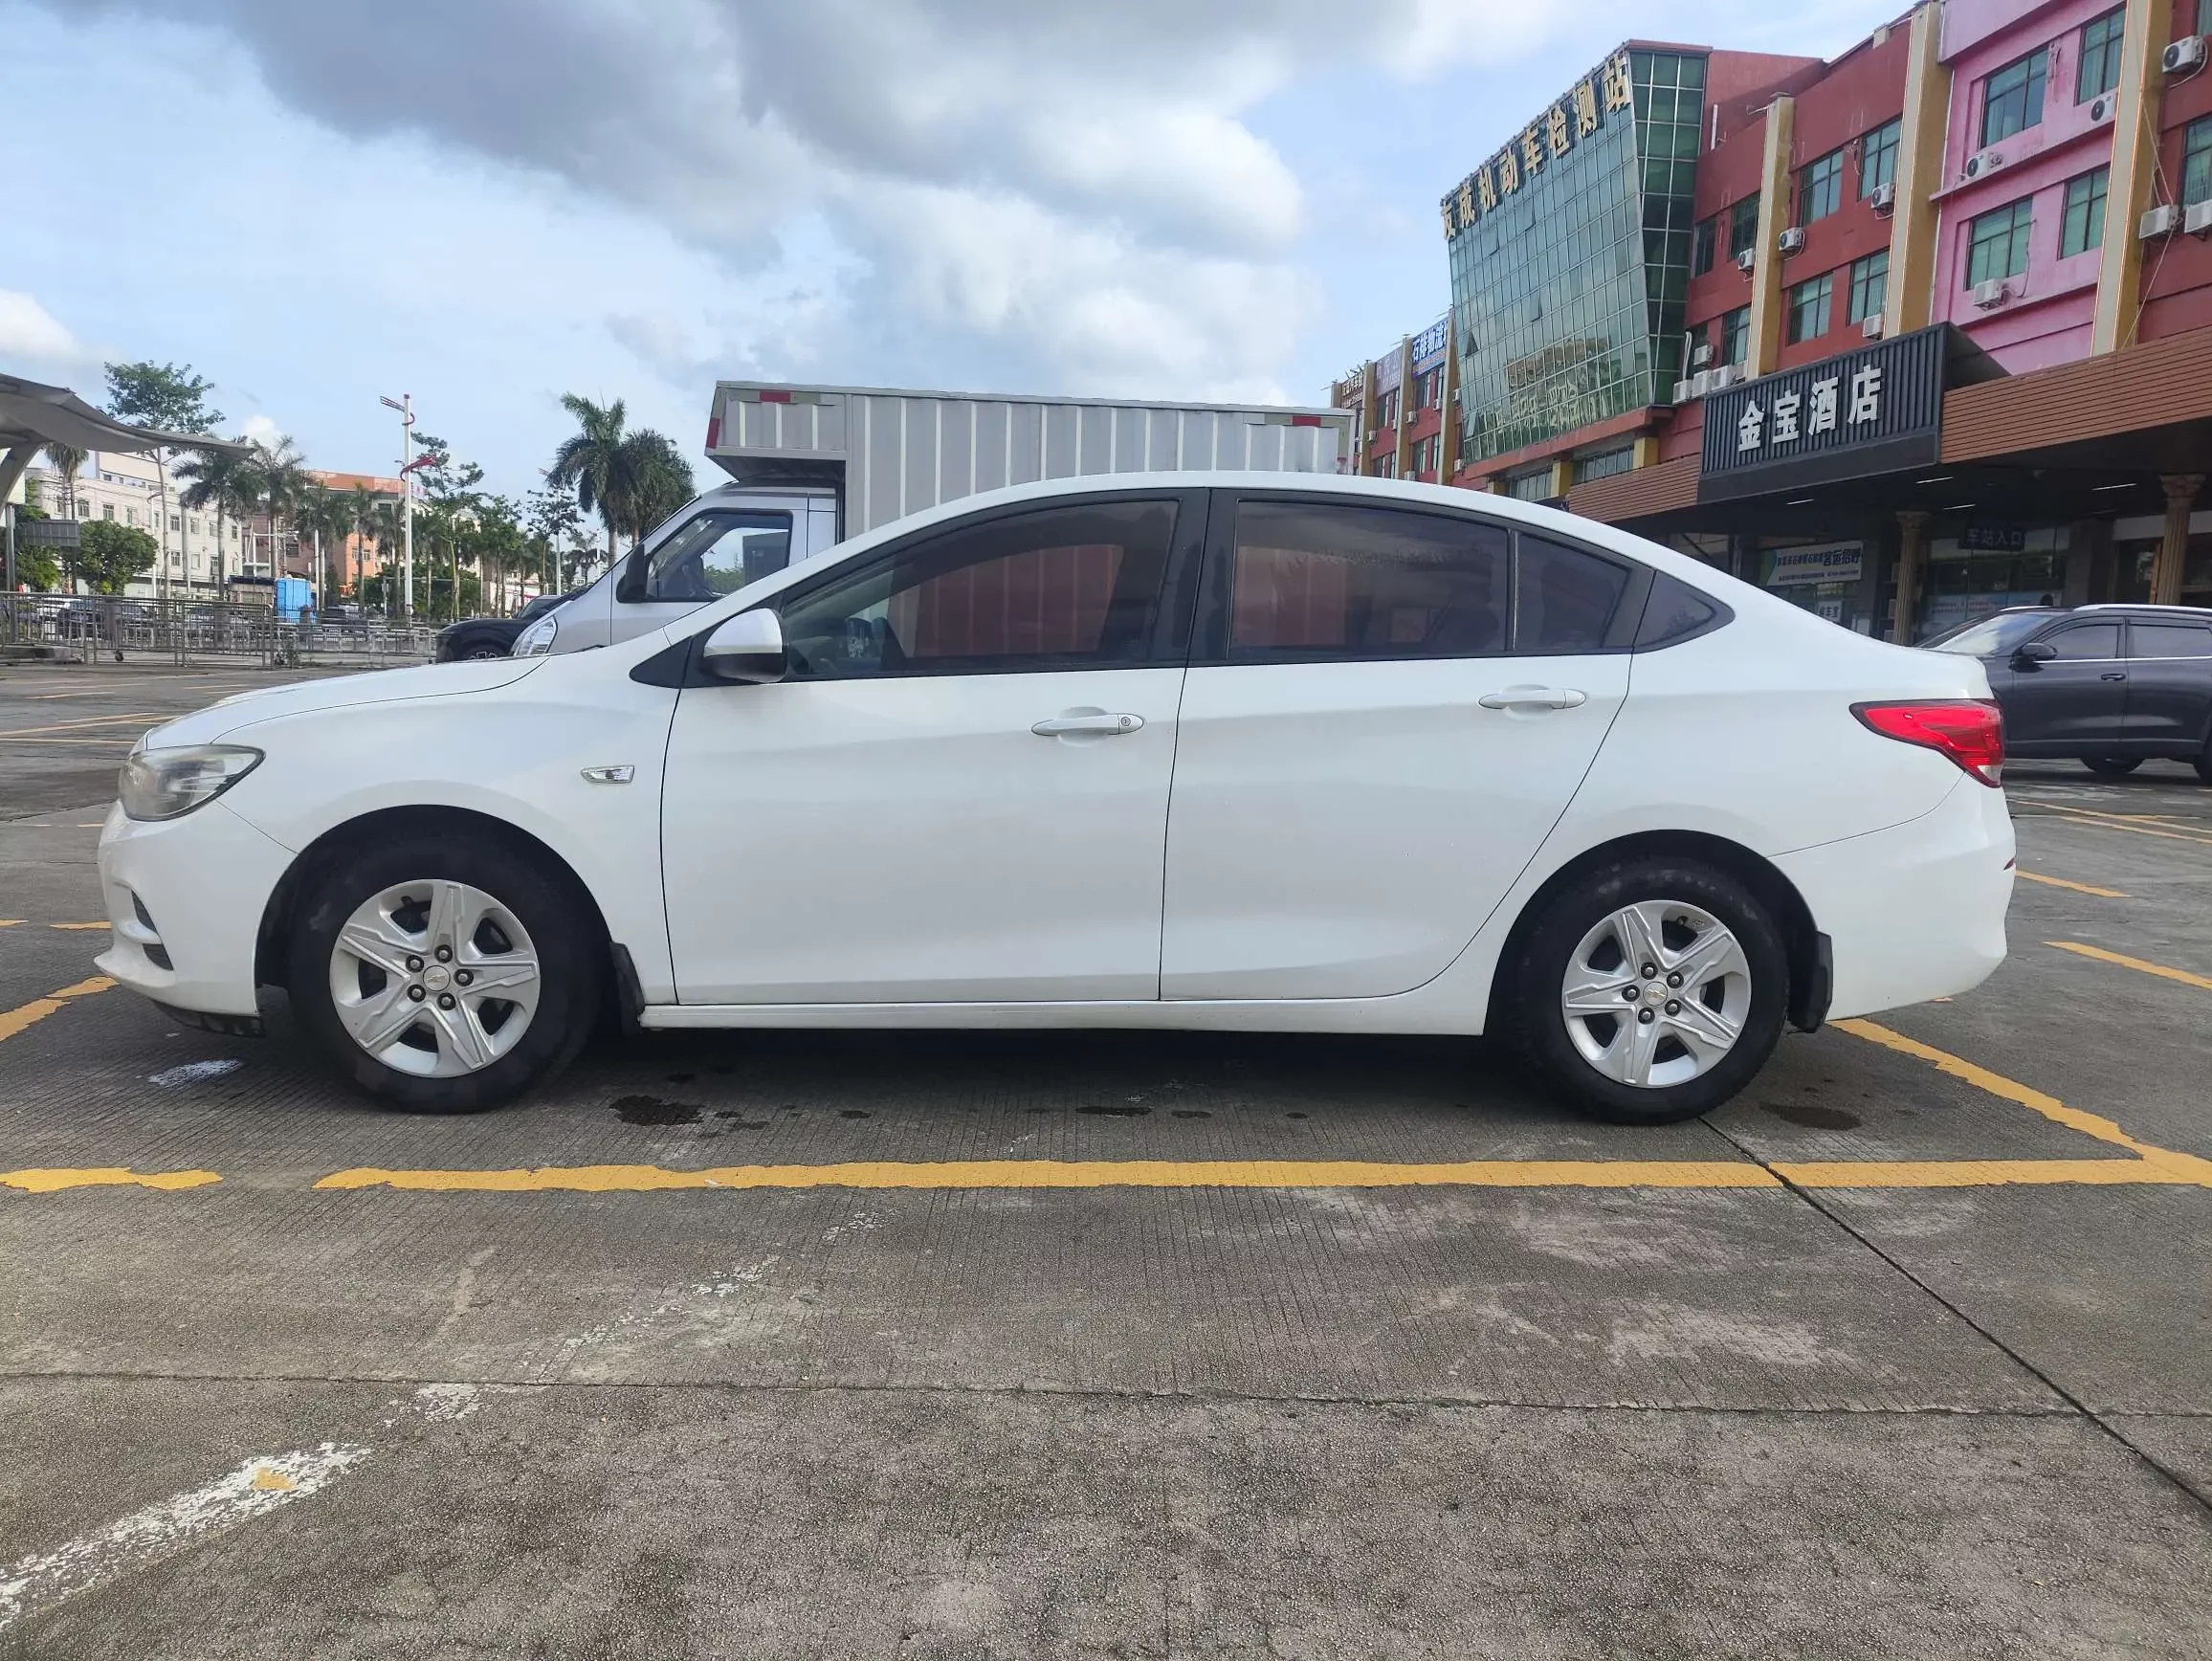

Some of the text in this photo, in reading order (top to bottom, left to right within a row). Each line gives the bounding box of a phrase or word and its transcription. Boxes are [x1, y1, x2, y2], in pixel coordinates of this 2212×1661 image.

[1737, 364, 1882, 452] 金宝酒店
[1966, 528, 2022, 546] 车站入口
